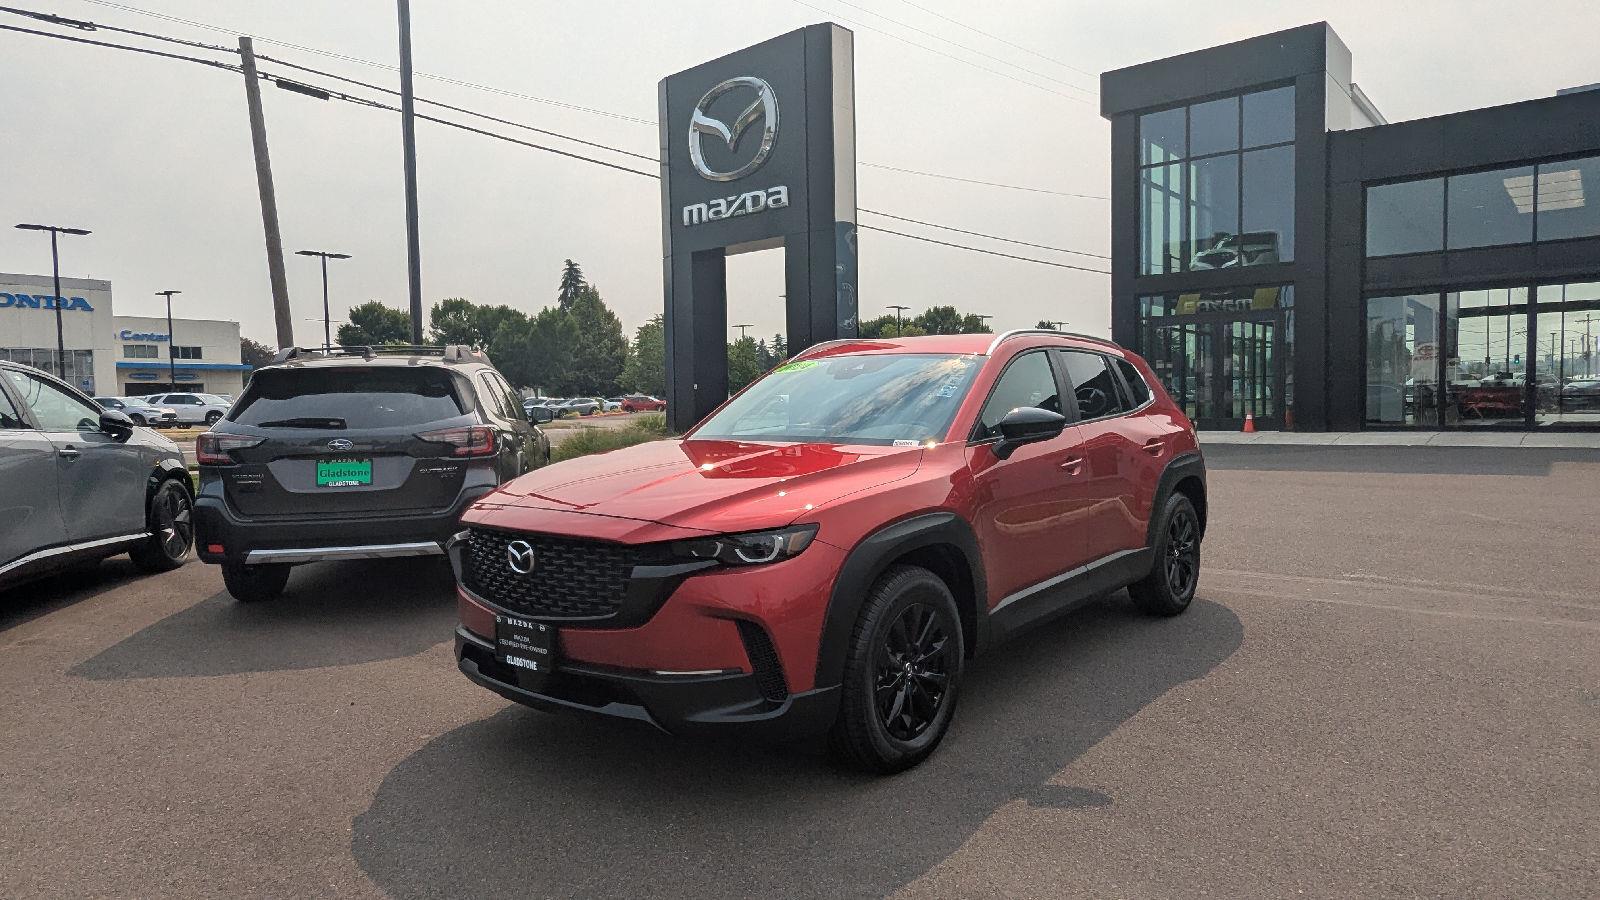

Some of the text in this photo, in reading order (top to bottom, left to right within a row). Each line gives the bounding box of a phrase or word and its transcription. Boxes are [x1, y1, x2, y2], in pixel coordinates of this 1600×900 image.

[320, 468, 370, 478] Gladstone
[507, 617, 533, 629] MAZDA
[506, 655, 537, 670] GLADSTONE
